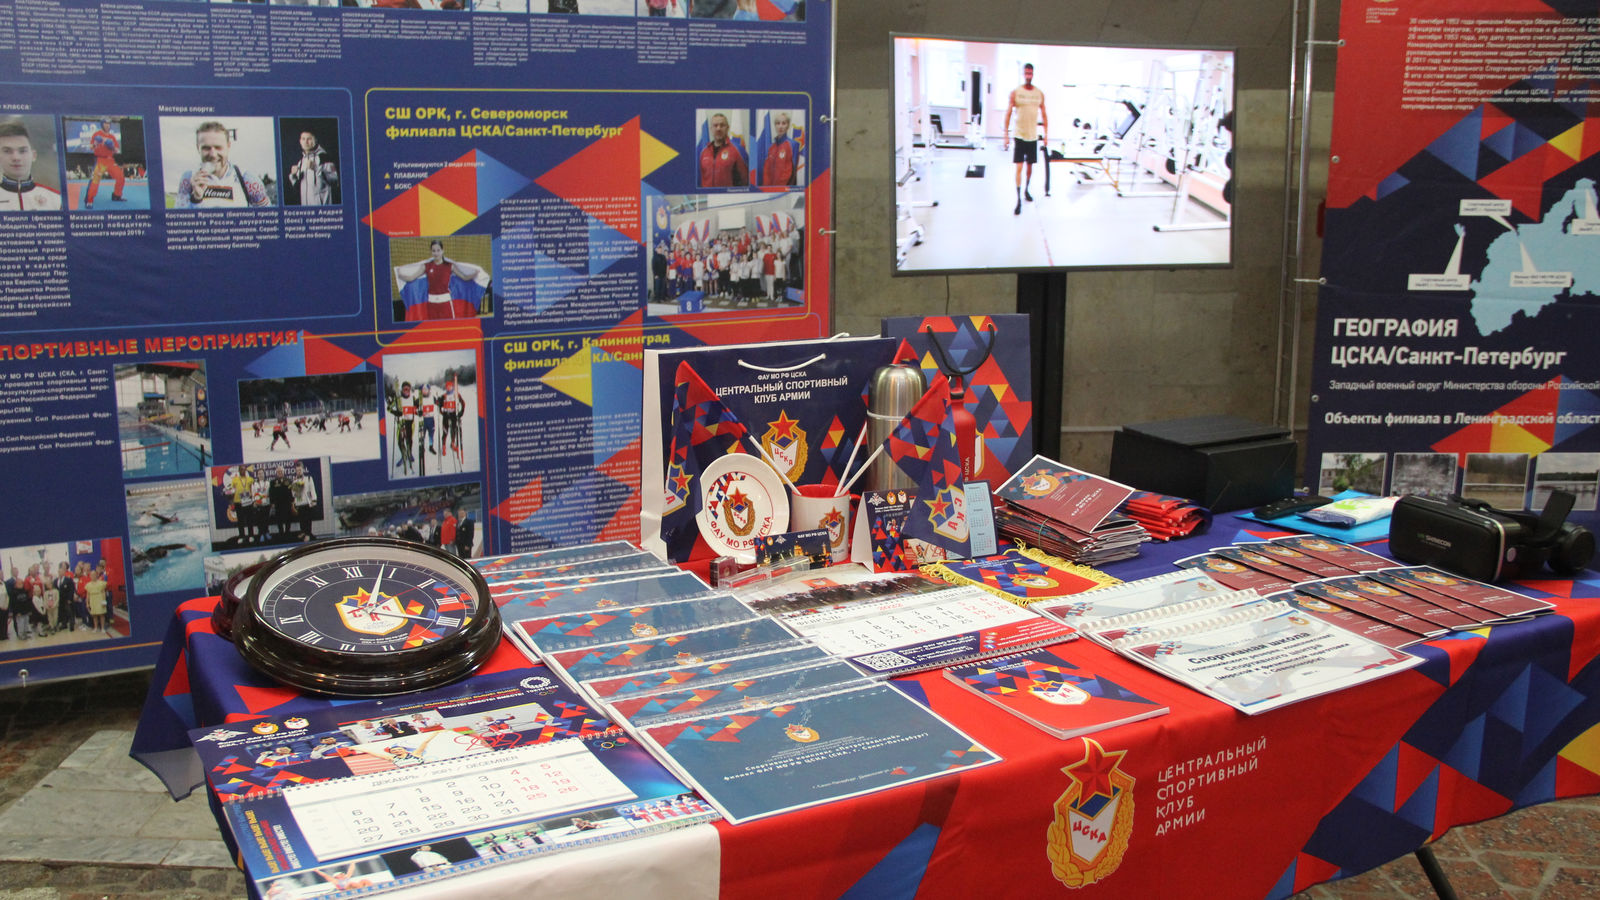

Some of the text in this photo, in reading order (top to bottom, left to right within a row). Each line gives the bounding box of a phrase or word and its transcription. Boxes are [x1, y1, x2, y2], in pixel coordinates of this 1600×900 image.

[384, 108, 569, 122] СШ ОРК, г. Североморск
[386, 124, 624, 140] филиала ЦСКА/Санкт-Петербург
[394, 172, 428, 180] ПЛАВАНИЕ
[1332, 318, 1459, 337] ГЕОГРАФИЯ
[144, 330, 298, 354] МЕРОПРИЯТИЯ
[504, 333, 671, 354] СШ ОРК, г. Калининград
[1330, 346, 1568, 370] ЦСКА/Санкт-Петербург
[24, 372, 35, 380] РФ
[38, 371, 57, 379] ЦСКА
[715, 375, 848, 396] ЦЕНТРАЛЬНЫЙ СПОРТИВНЫЙ
[1328, 380, 1600, 392] Западный военный округ Министерства обороны Российской
[514, 392, 557, 402] ГРЕБНОЙ СПОРТ
[754, 391, 811, 404] КЛУБ АРМИИ
[1324, 412, 1382, 425] Объекты
[1384, 412, 1440, 426] филиала
[1443, 416, 1452, 424] в
[1454, 412, 1554, 425] Ленинградской
[774, 447, 794, 466] ЦСКА
[710, 520, 755, 548] ФАУ МО РФ
[305, 576, 330, 588] XI
[342, 566, 364, 580] XII
[387, 568, 398, 579] I
[416, 578, 437, 589] II
[282, 595, 306, 603] X
[436, 596, 460, 606] III
[877, 602, 904, 611] 2022
[279, 614, 304, 625] IX
[795, 614, 842, 629] ФЕВРАЛЬ
[1187, 643, 1268, 664] Спортивная
[1269, 631, 1311, 648] школа
[1224, 644, 1324, 672] Спортивного центра
[217, 738, 248, 746] Филиал
[288, 728, 309, 737] ЦСКА
[218, 742, 239, 750] (СКА,
[745, 757, 794, 772] Спортивный
[796, 750, 833, 762] комплекс
[756, 766, 774, 774] ФАУ
[790, 760, 802, 768] РФ
[804, 754, 828, 764] ЦСКА
[828, 750, 851, 760] (СКА,
[861, 732, 930, 750] Санкт-Петербург)
[1158, 736, 1267, 782] ЦЕНТРАЛЬНЫЙ
[372, 775, 420, 787] ДЕКАБРЬ
[466, 754, 518, 770] DECEMBER
[1156, 755, 1259, 800] СПОРТИВНЫЙ
[419, 796, 431, 804] 8
[482, 782, 501, 791] 10
[514, 776, 531, 784] 11
[545, 770, 562, 778] 12
[353, 778, 572, 826] 13 14 15 16 17 18 19
[356, 785, 579, 836] 20 21 22 23 24 25 26
[1156, 796, 1194, 818] КЛУБ
[363, 807, 520, 843] 27 28 29 30 31
[1156, 808, 1206, 836] АРМИИ
[1072, 820, 1107, 844] ЦСКА
